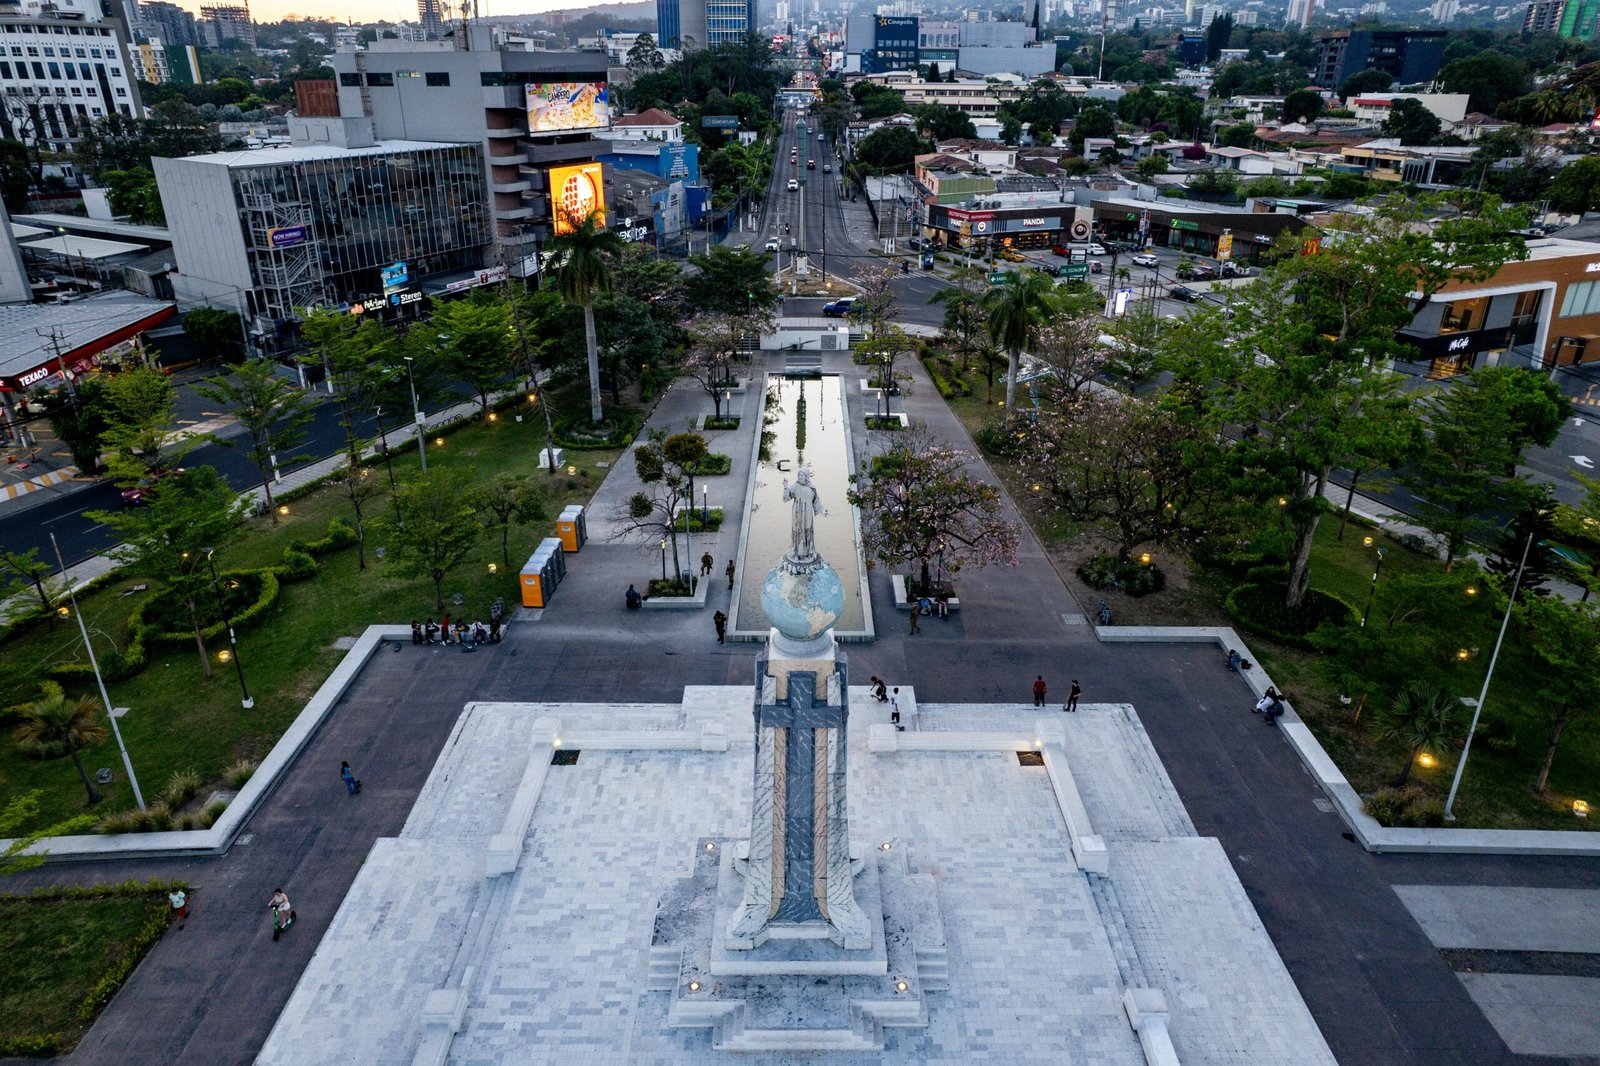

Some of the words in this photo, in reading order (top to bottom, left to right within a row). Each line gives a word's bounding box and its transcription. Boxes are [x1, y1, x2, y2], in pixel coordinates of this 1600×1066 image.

[887, 18, 914, 26] Cinépolis
[547, 90, 570, 102] CAMPERO
[1023, 218, 1045, 226] PANDA
[400, 292, 422, 302] Steren
[19, 367, 49, 387] TEXACO
